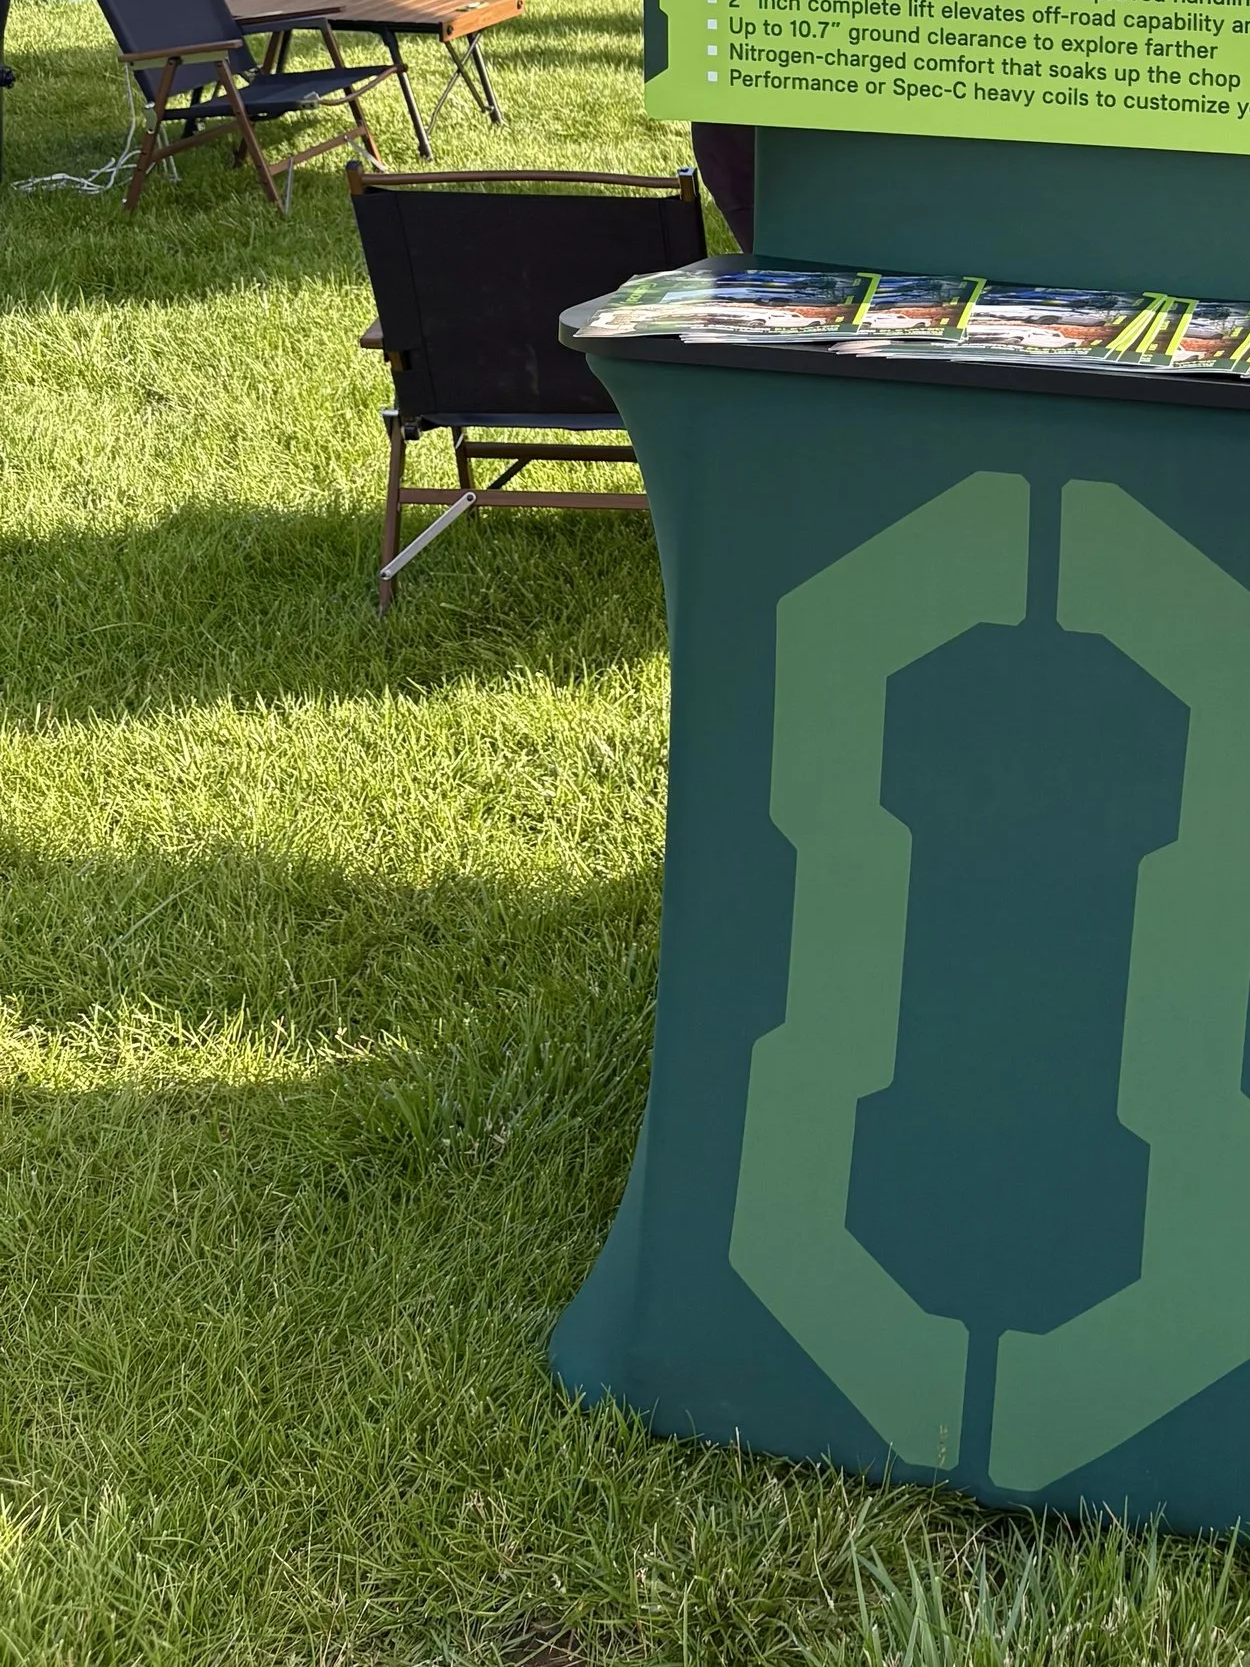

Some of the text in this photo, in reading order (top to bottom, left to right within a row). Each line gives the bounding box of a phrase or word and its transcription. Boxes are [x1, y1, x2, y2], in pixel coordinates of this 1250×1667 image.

[729, 16, 757, 40] Up
[762, 19, 783, 37] to
[848, 25, 920, 46] ground
[927, 27, 1027, 50] clearance
[1033, 33, 1054, 51] to
[1061, 35, 1138, 58] explore
[1144, 37, 1219, 60] farther
[941, 0, 1026, 23] elevates
[1032, 5, 1116, 28] off-road
[1123, 11, 1225, 37] capability
[729, 42, 1241, 93] Nitrogen-charged comfort that soaks up the chop
[730, 68, 859, 94] Performance
[865, 81, 887, 95] or
[892, 77, 967, 102] Spec-C
[974, 82, 1036, 108] heavy
[1042, 87, 1089, 107] coils
[1095, 90, 1117, 108] to
[1123, 93, 1230, 115] customize
